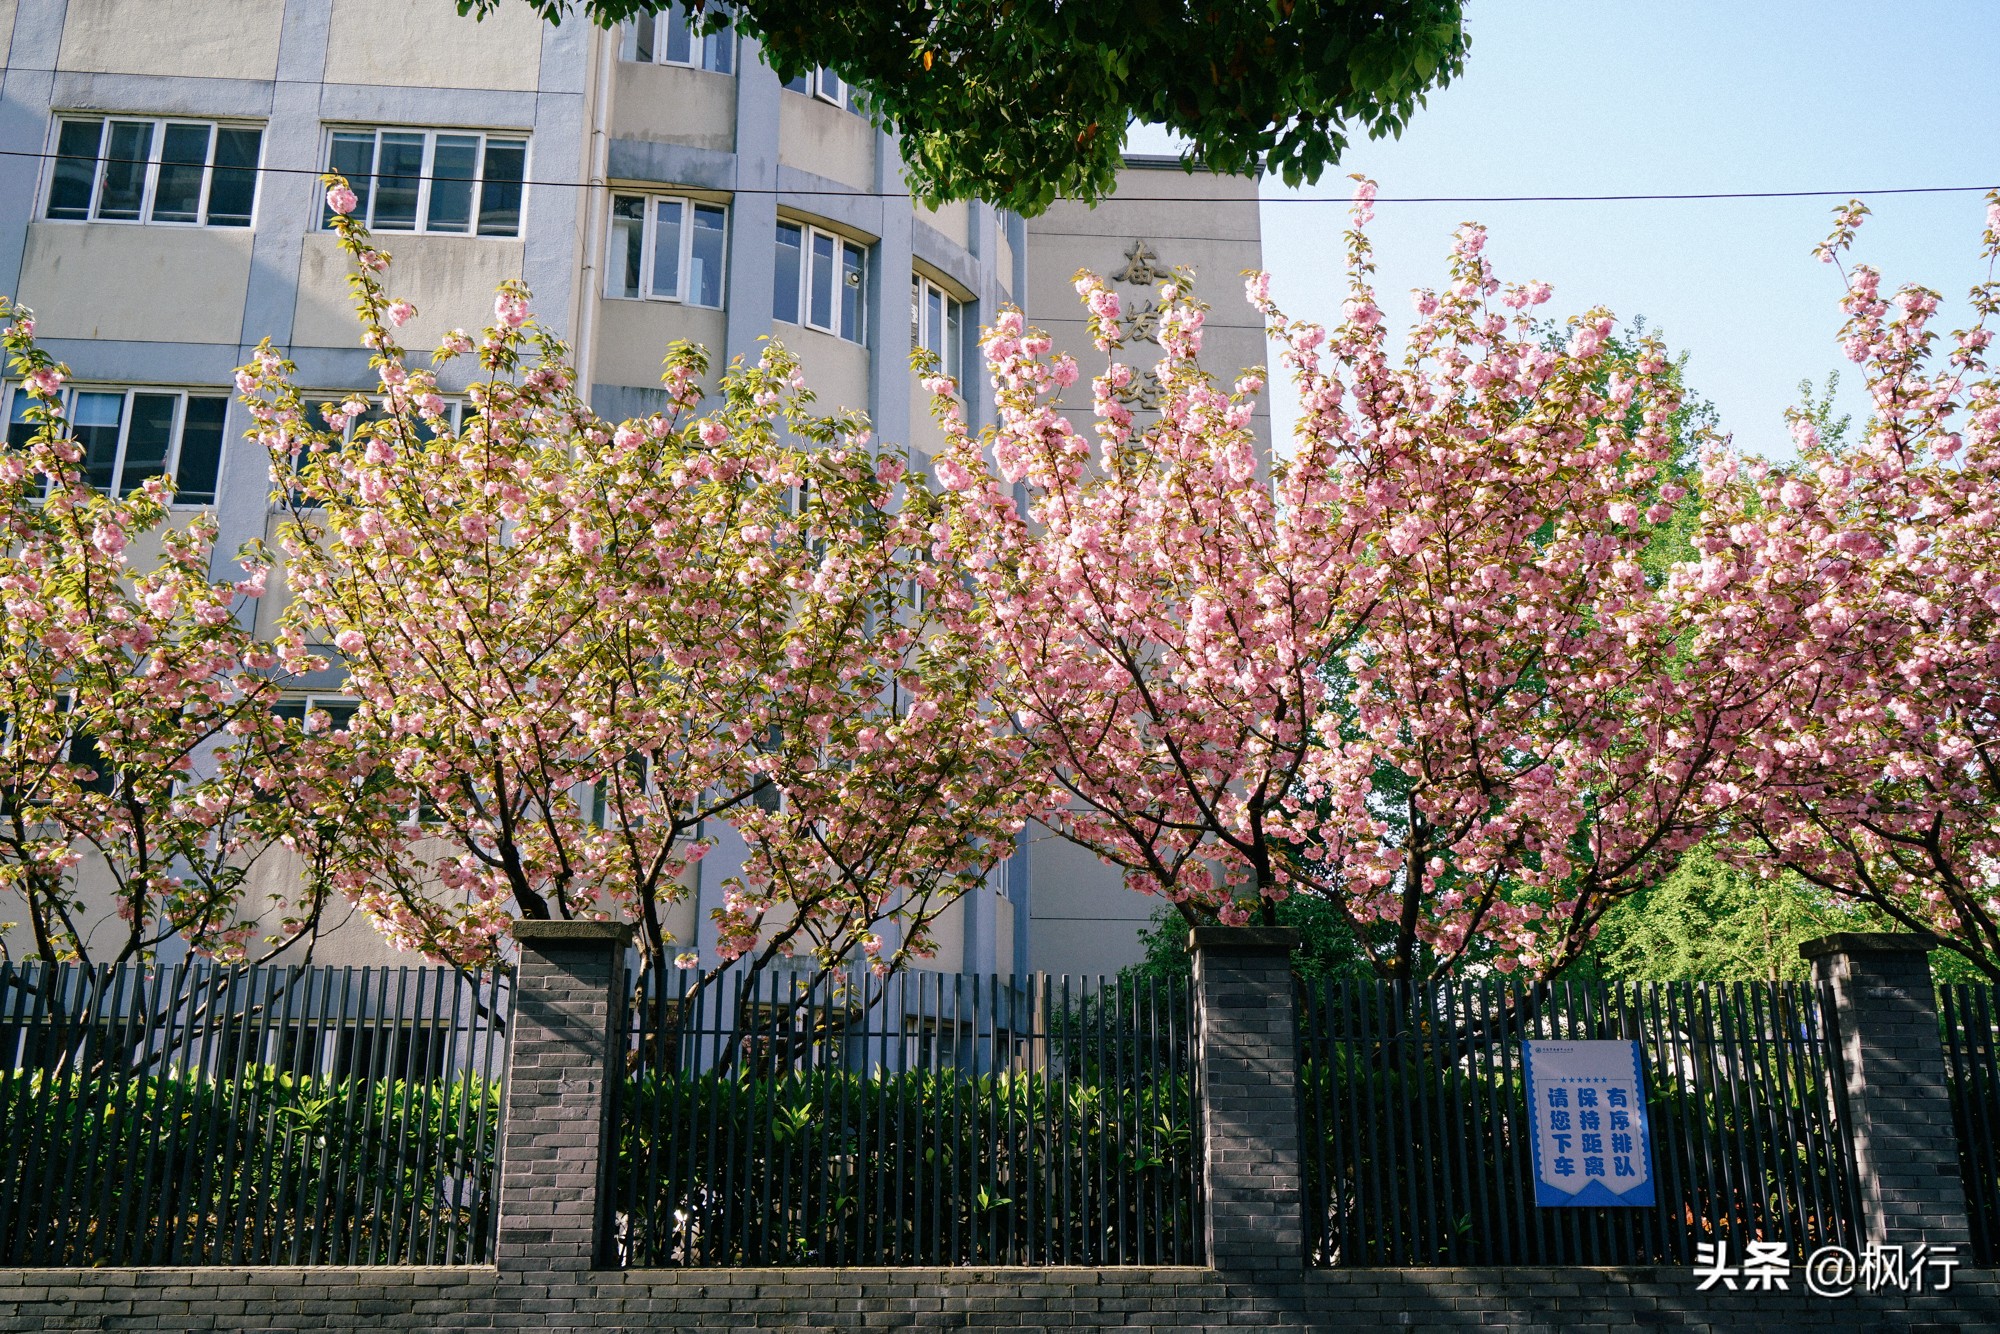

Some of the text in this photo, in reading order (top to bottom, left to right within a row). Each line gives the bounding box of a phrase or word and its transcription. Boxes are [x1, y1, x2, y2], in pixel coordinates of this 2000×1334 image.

[1547, 1087, 1575, 1177] 请您下车
[1577, 1087, 1605, 1177] 保持距离
[1606, 1087, 1635, 1177] 有序排队
